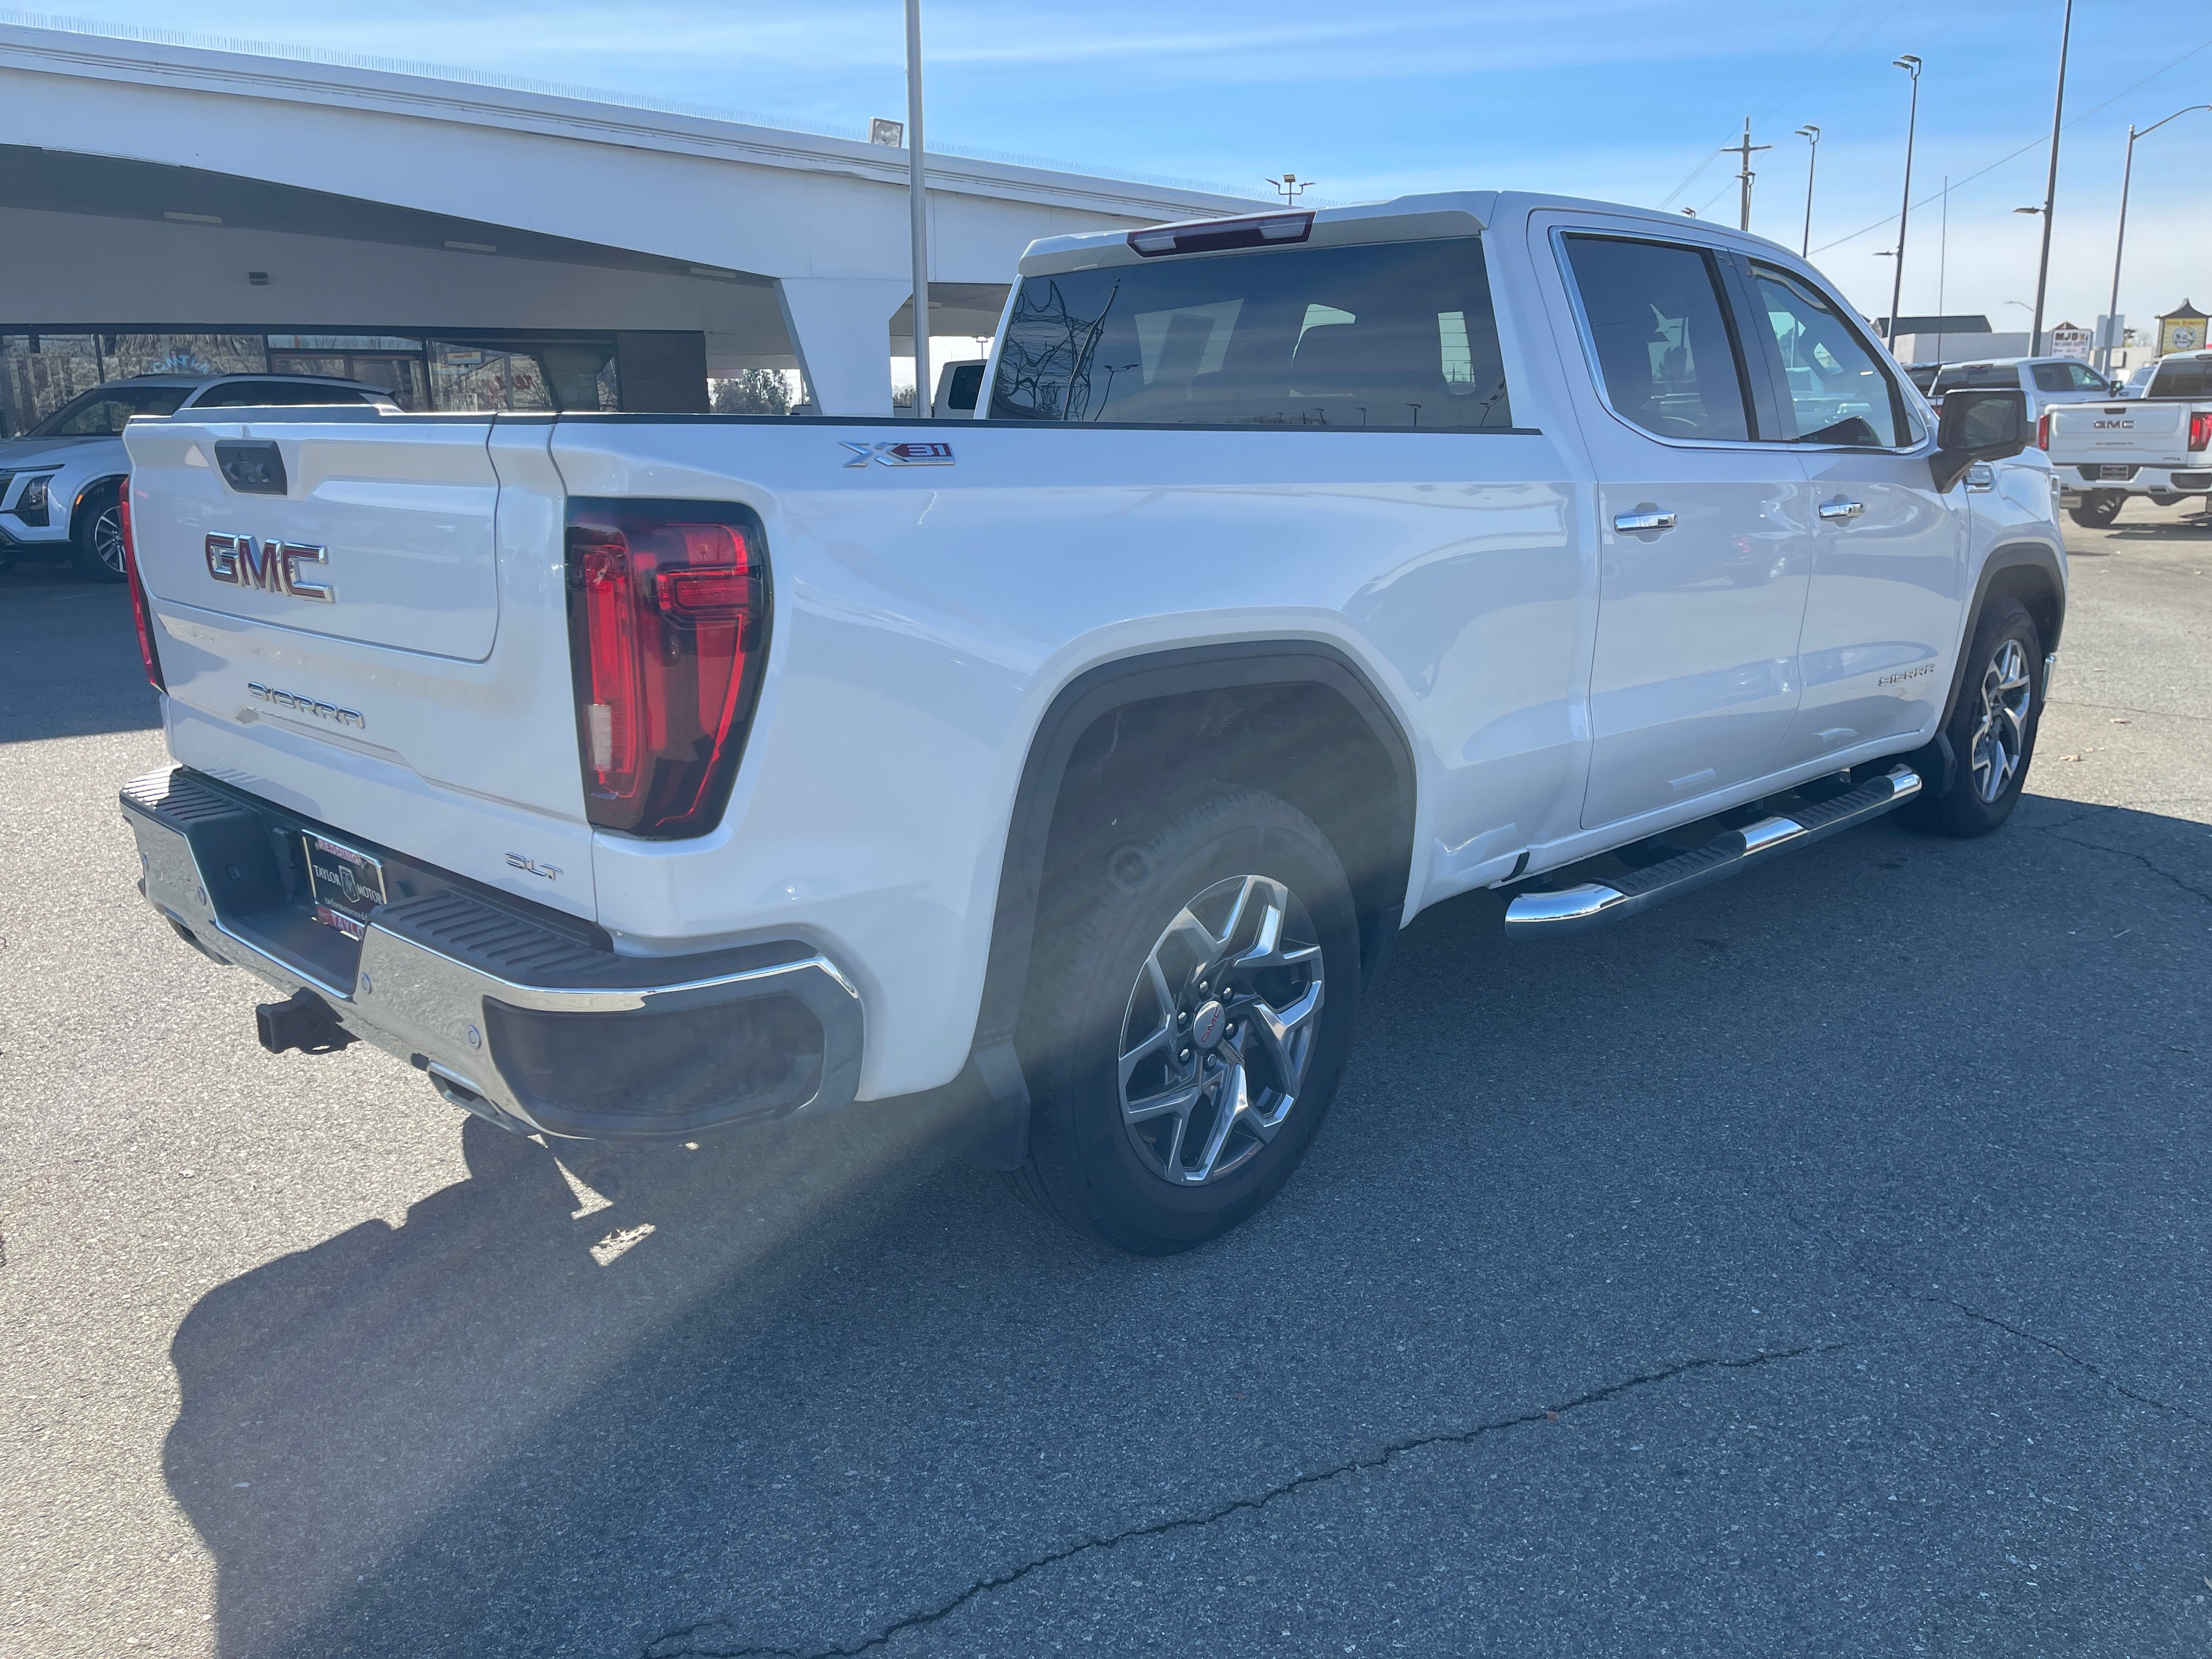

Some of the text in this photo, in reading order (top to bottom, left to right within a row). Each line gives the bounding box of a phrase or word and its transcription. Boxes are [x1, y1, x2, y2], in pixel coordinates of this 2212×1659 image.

[2094, 420, 2136, 428] GMC
[205, 531, 335, 603] GMC
[1878, 663, 1936, 686] SIERRA
[248, 681, 365, 729] SIERRA
[313, 865, 342, 887] TAYLOR
[504, 852, 563, 881] SLT
[1200, 1005, 1221, 1043] GMC
